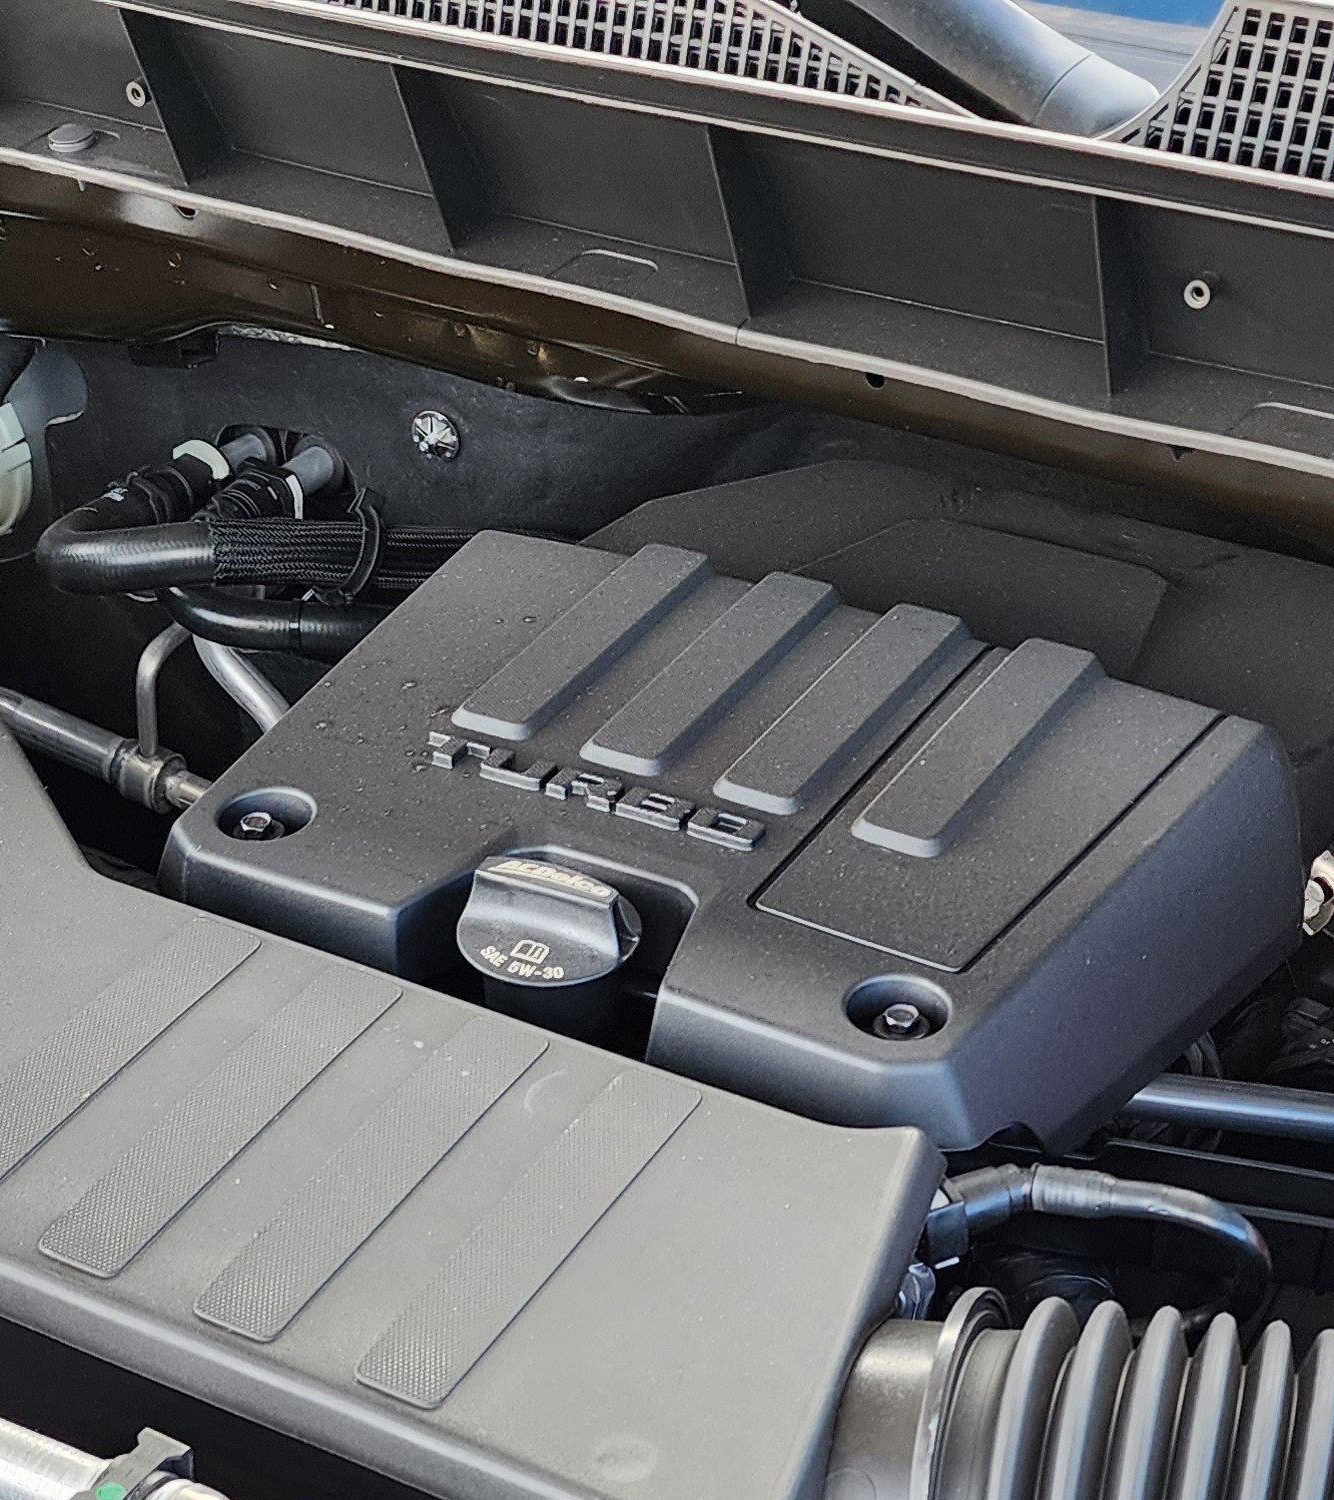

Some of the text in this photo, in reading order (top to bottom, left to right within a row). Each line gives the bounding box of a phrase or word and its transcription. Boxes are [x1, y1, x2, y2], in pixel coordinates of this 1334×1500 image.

[428, 732, 765, 852] TURBO
[488, 859, 612, 898] ACDelco
[480, 945, 565, 980] SAE 5W-30
